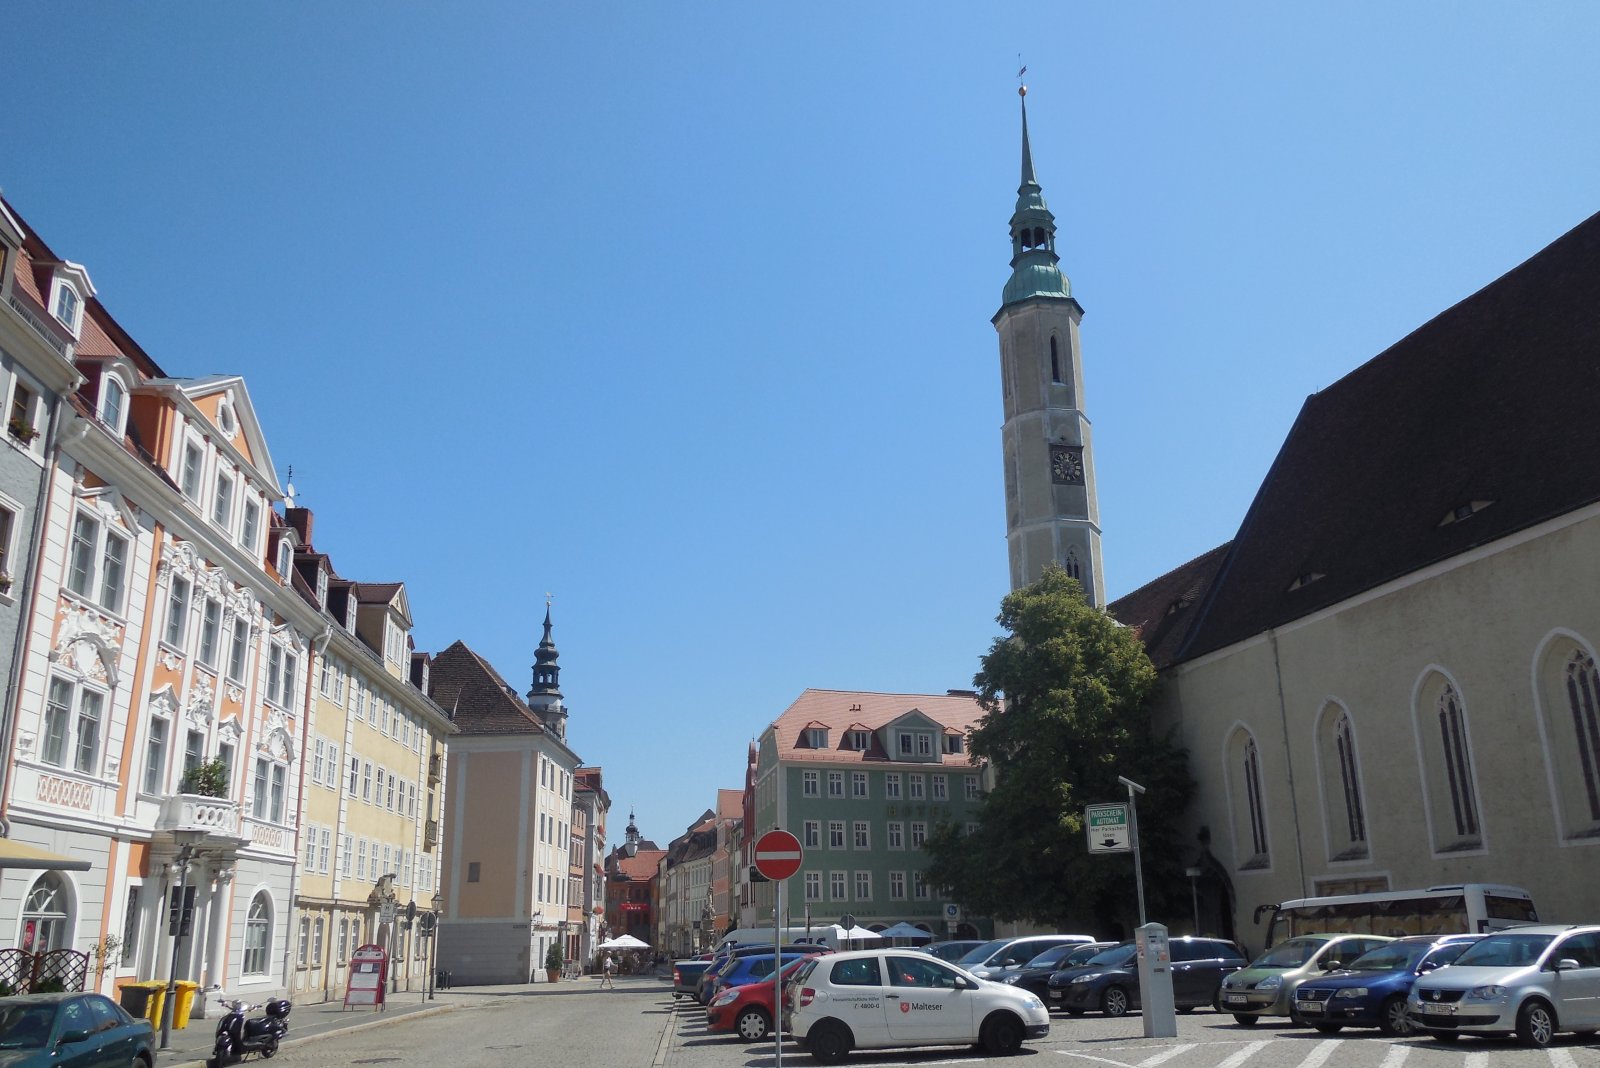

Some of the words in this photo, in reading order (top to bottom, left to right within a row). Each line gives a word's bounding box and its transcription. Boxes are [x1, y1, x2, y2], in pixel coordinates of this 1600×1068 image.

[1090, 809, 1124, 817] PARKSCHEIN-
[1097, 817, 1119, 825] AUTOMAT
[911, 1002, 943, 1010] Malteser
